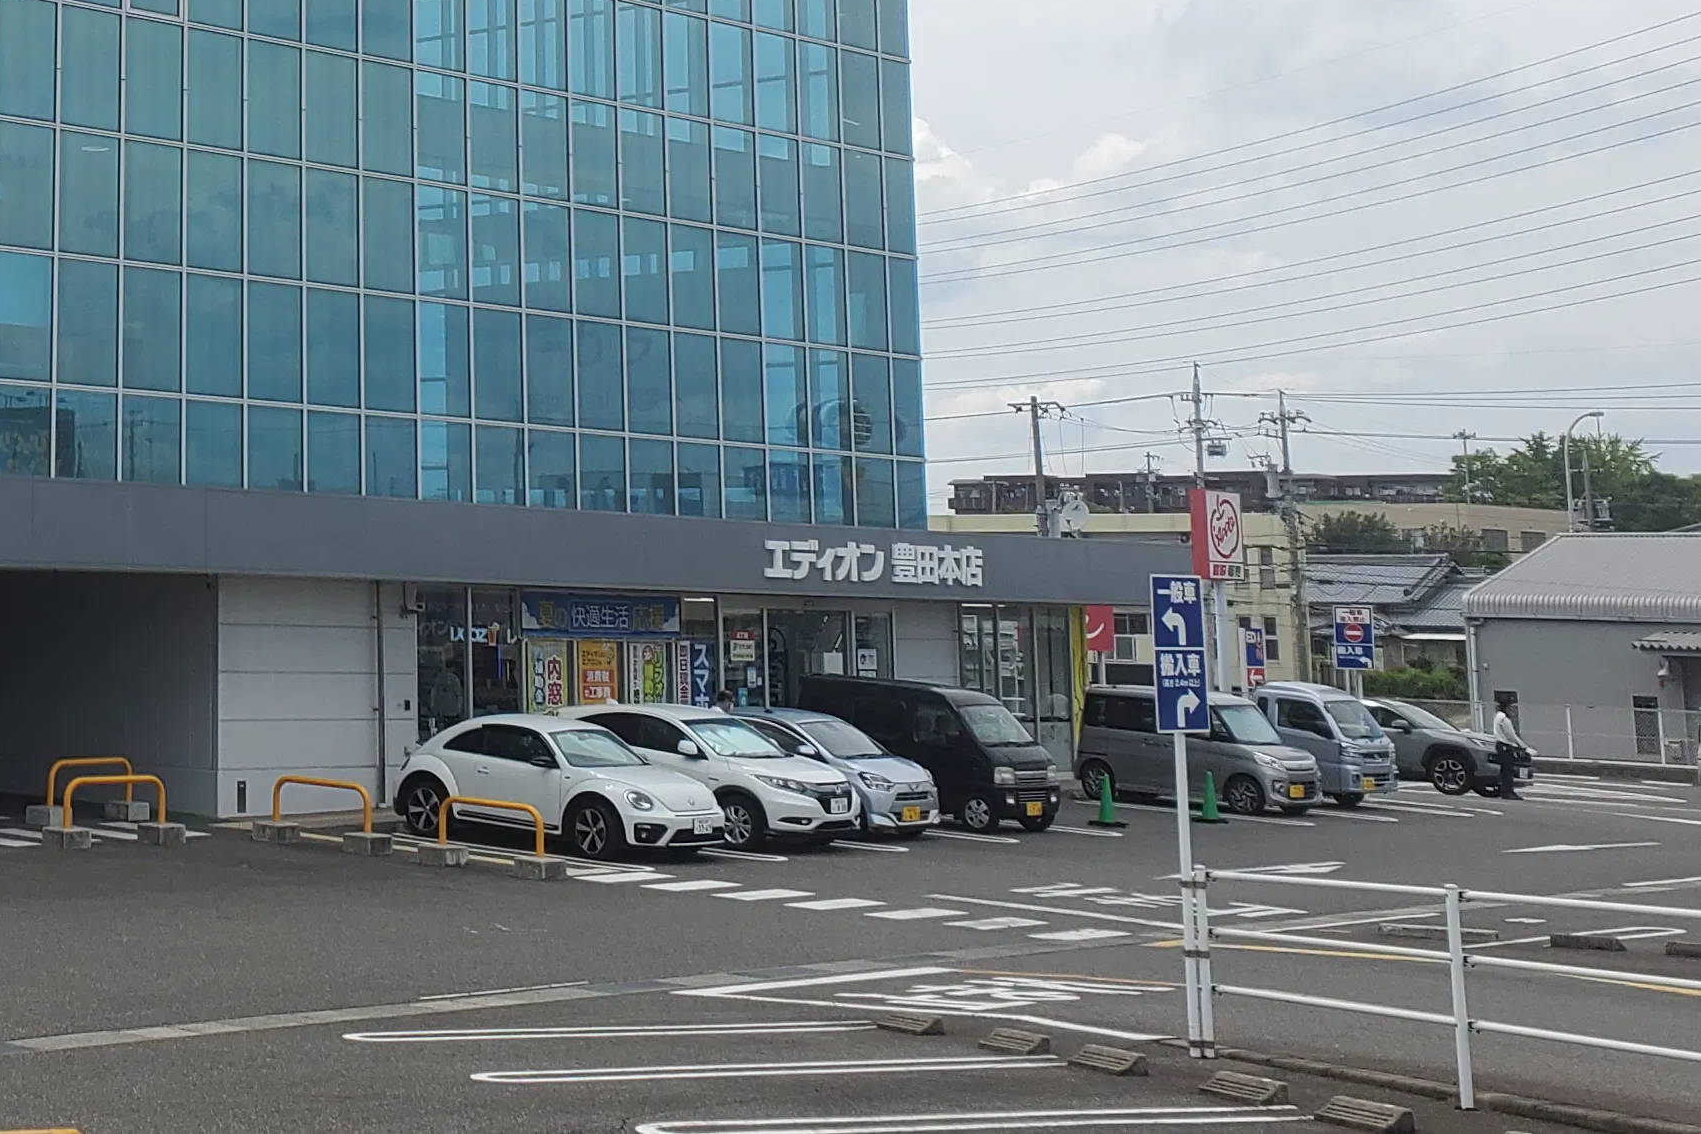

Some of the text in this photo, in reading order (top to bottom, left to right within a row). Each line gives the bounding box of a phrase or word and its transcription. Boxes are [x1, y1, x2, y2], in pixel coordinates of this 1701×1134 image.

[764, 539, 983, 587] エディオン 豊田本店
[1157, 581, 1197, 604] 一般車
[693, 643, 710, 708] スマホ
[1160, 653, 1201, 677] 搬入車
[833, 976, 1177, 1011] 止まれ
